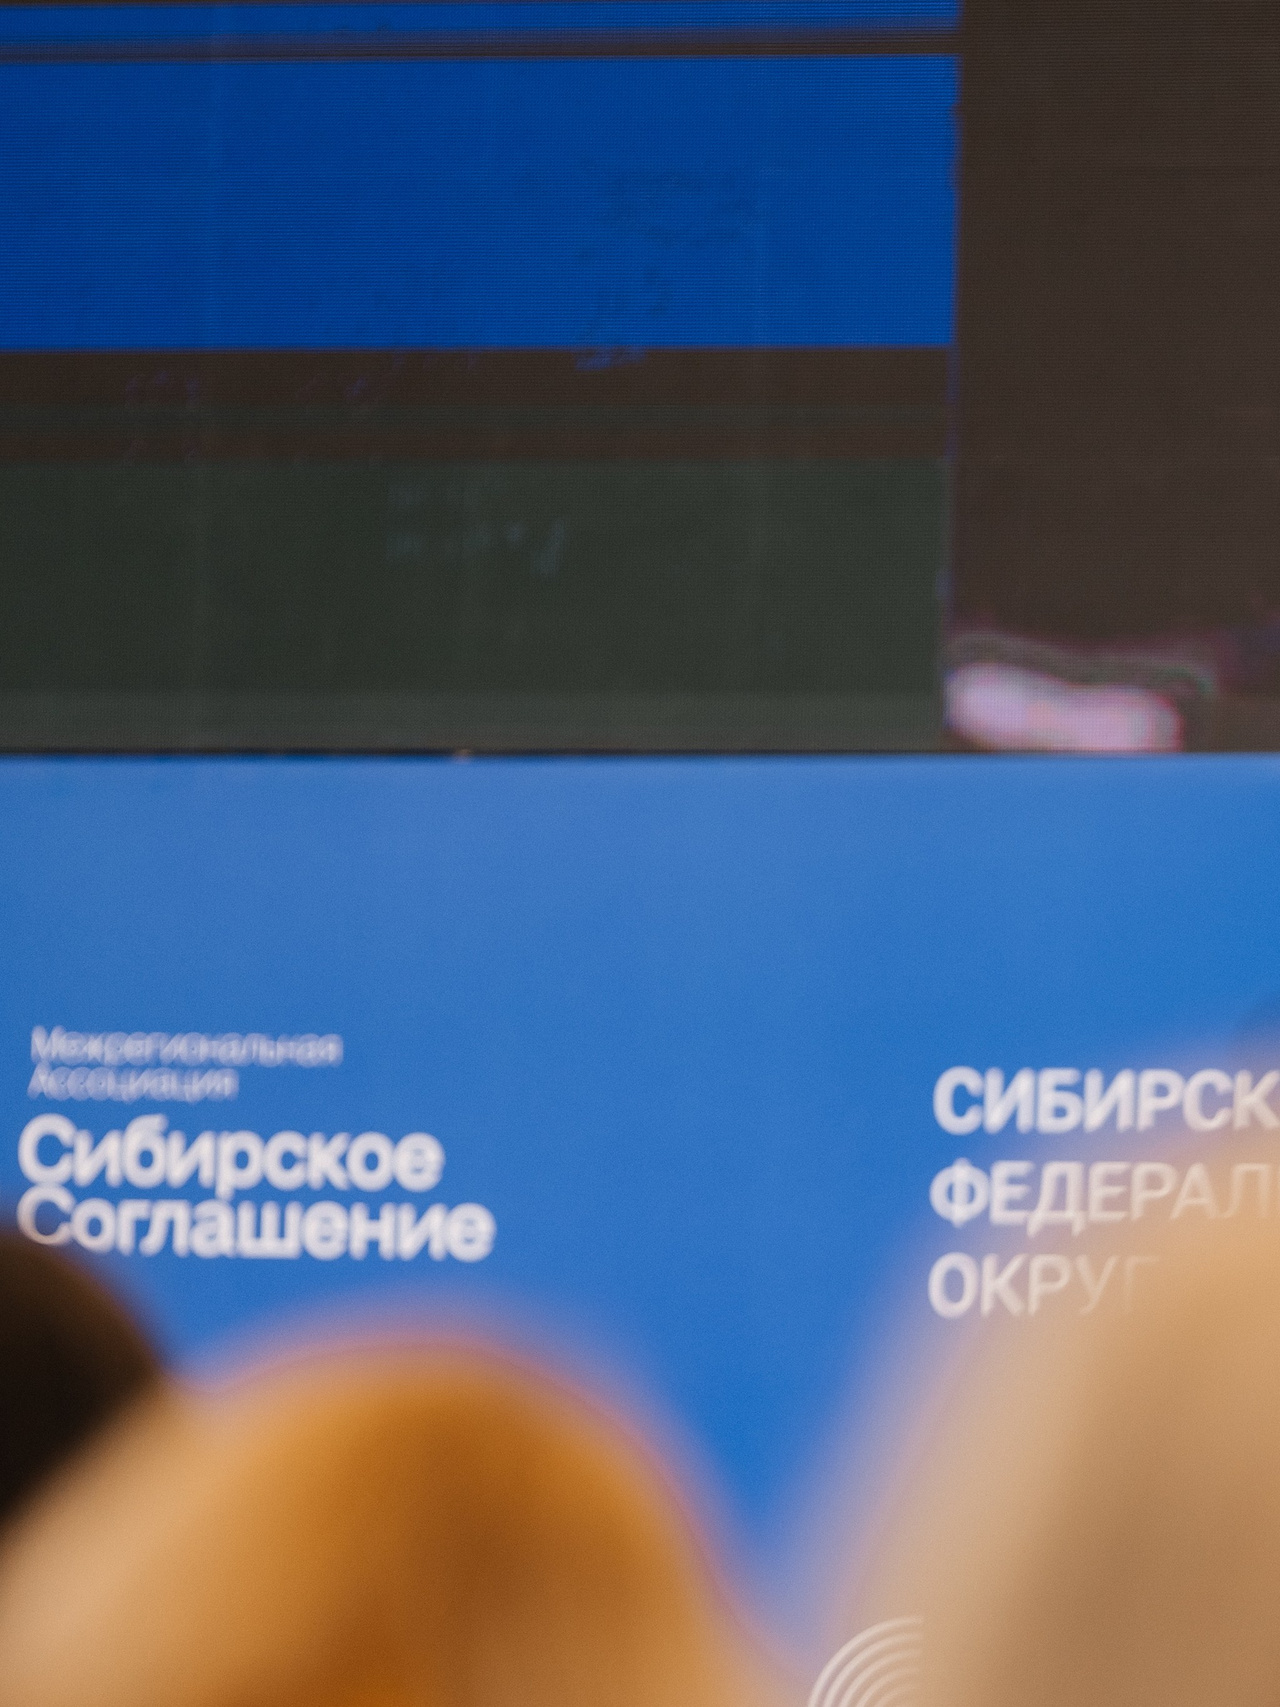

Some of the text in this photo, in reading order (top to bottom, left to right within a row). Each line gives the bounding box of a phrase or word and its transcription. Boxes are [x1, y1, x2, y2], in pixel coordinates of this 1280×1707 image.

[30, 1026, 344, 1068] Межрегиональная
[27, 1061, 240, 1103] Ассоциация
[18, 1113, 446, 1200] Сибирское
[17, 1183, 496, 1262] Соглашение
[928, 1251, 1160, 1319] ОКРУГ
